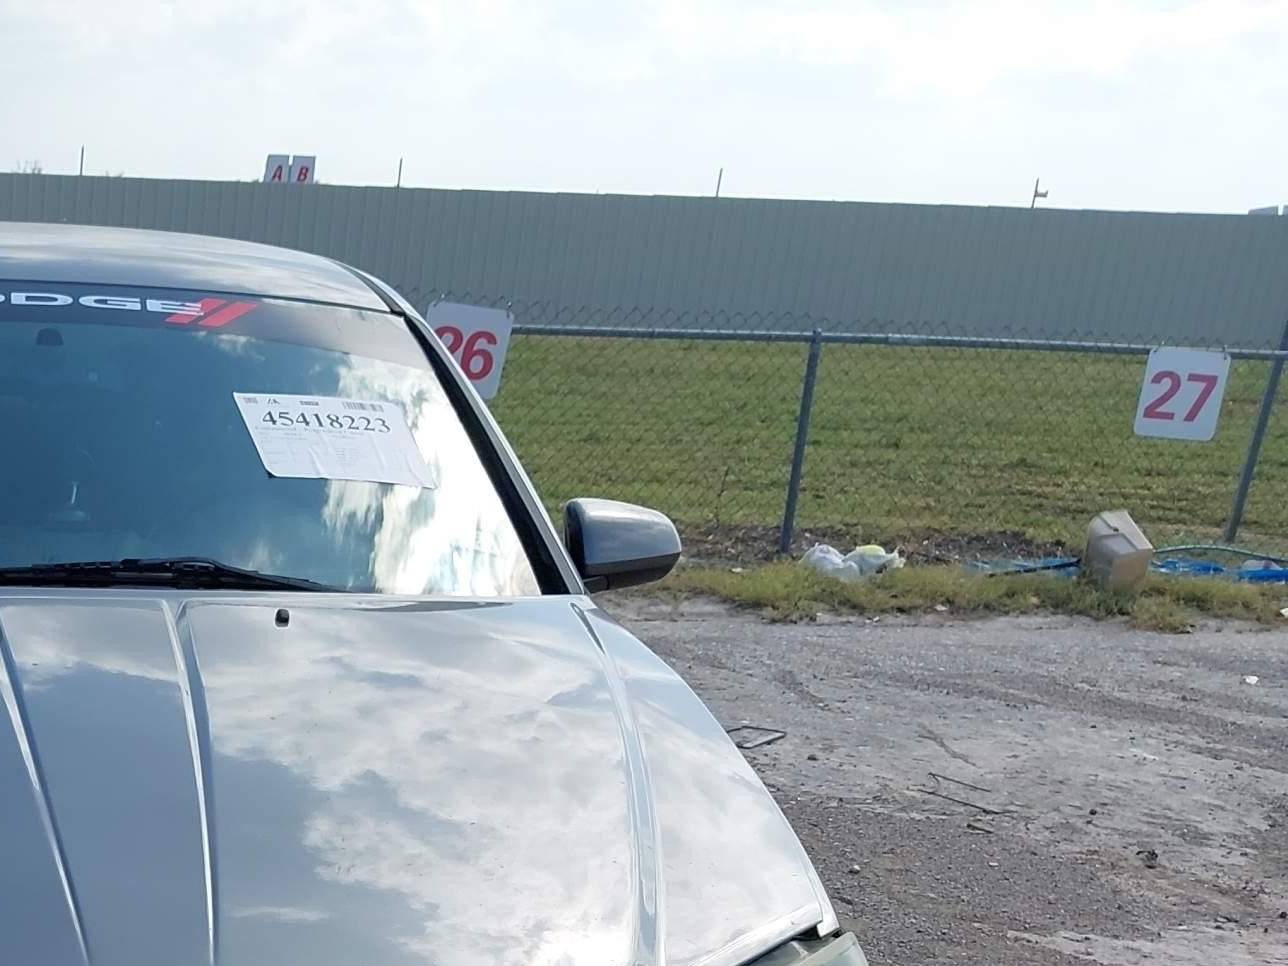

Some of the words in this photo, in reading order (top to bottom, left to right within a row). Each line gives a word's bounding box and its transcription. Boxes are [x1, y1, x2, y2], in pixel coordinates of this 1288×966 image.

[272, 164, 283, 181] A
[296, 165, 309, 182] B
[1143, 370, 1219, 422] 27
[262, 410, 391, 434] 45418223
